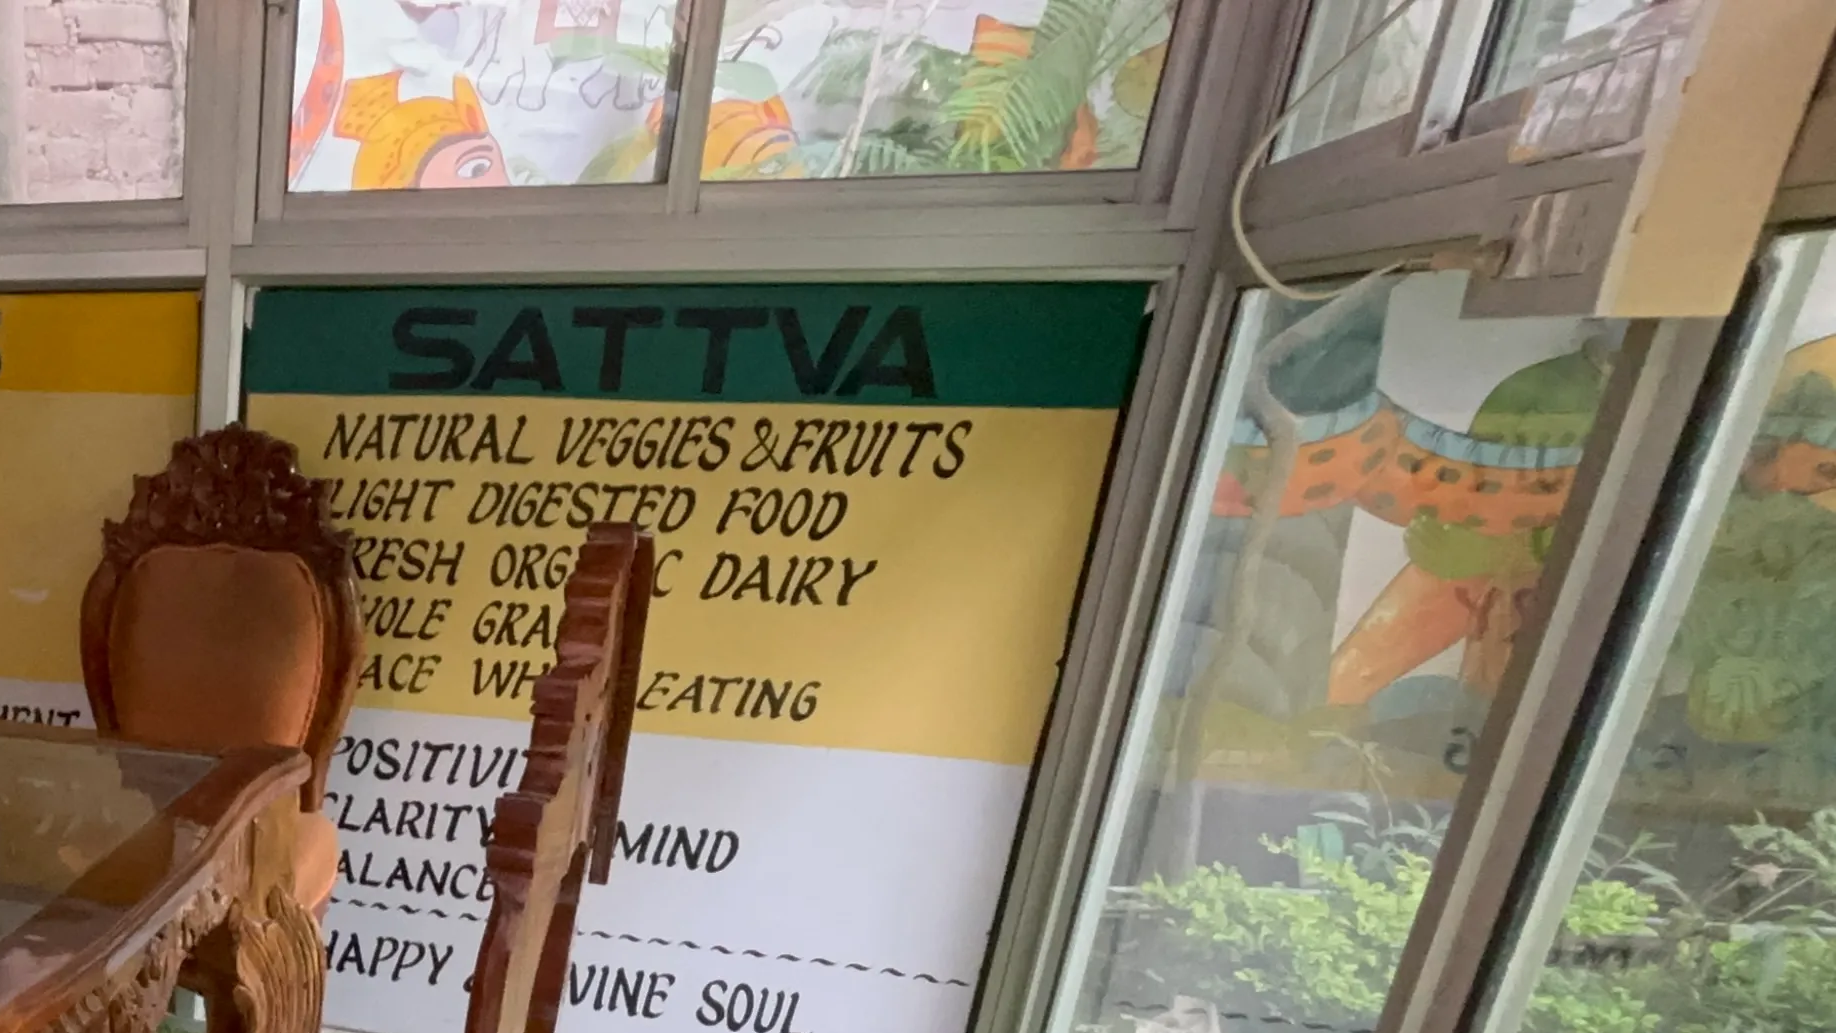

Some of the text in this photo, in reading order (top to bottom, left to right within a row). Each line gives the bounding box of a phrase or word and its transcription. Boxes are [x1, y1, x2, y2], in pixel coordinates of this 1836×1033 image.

[388, 305, 938, 399] SATTVA
[323, 413, 535, 465] NATURAL
[555, 417, 734, 472] VEGGIES
[467, 480, 696, 533] DIGESTED
[716, 486, 849, 541] FOOD
[352, 536, 465, 587] RESH
[701, 553, 879, 607] DAIRY
[635, 671, 821, 722] EATING
[613, 820, 741, 873] MIND
[568, 961, 676, 1019] VINE
